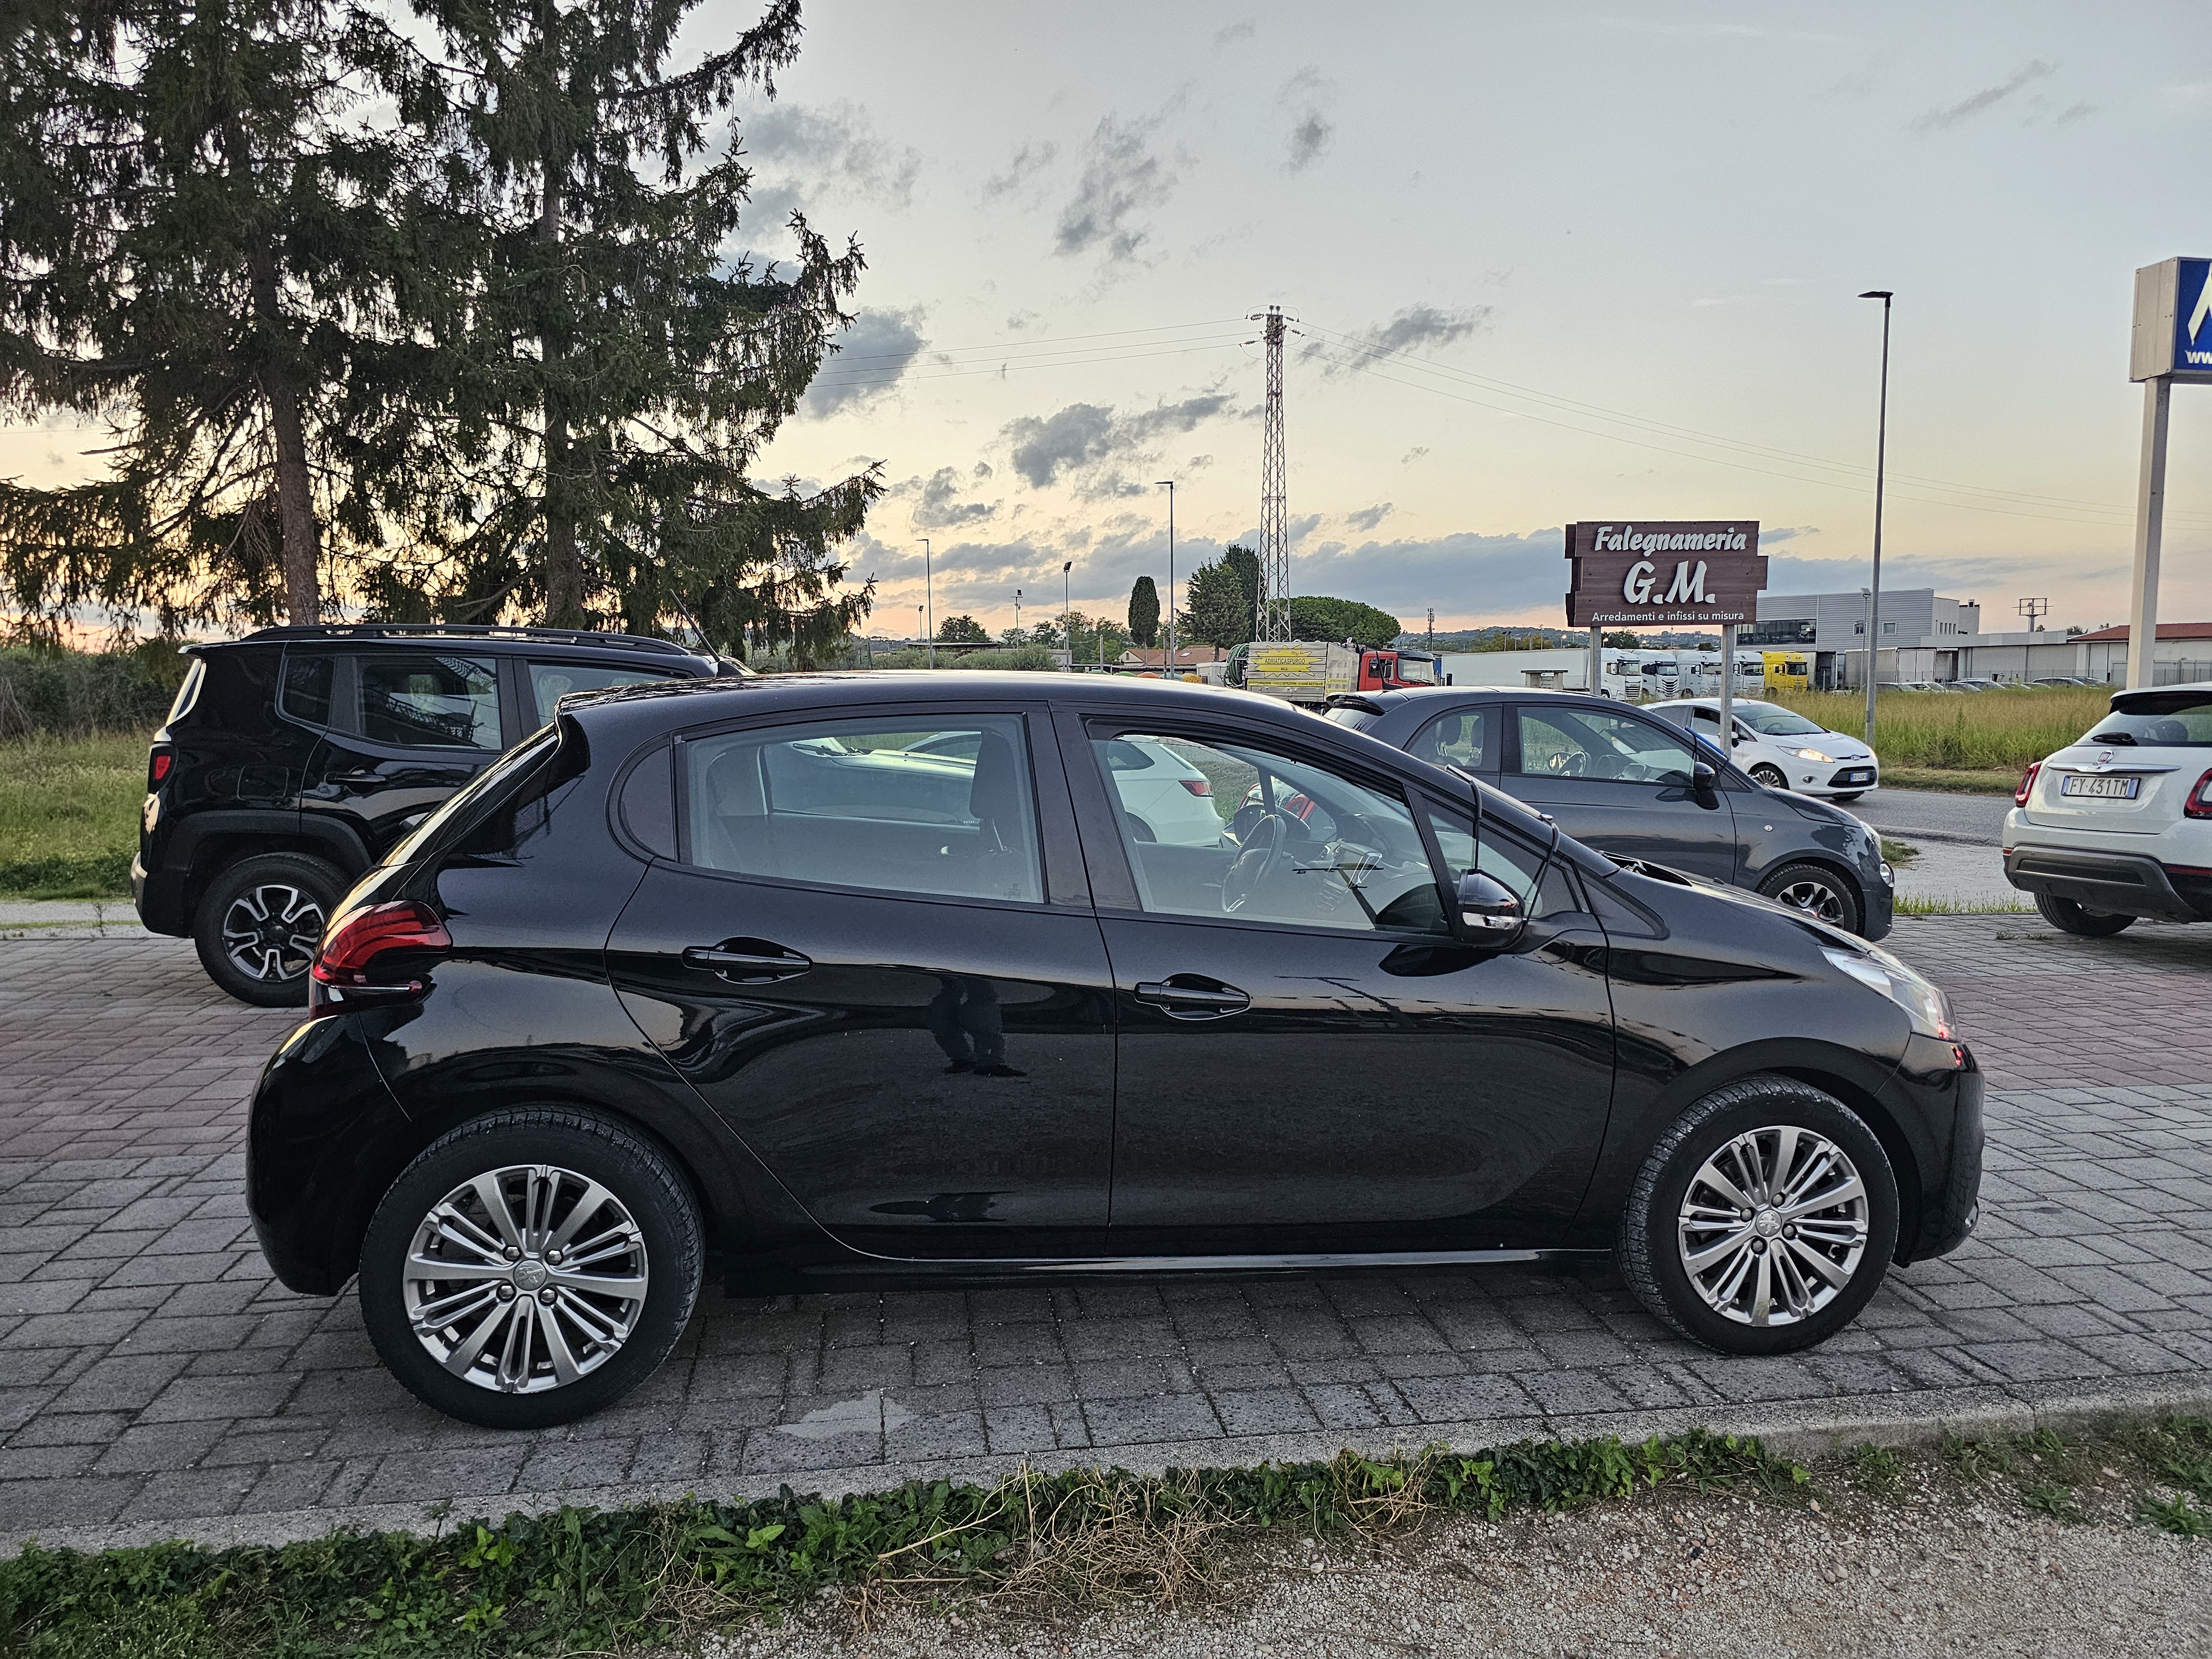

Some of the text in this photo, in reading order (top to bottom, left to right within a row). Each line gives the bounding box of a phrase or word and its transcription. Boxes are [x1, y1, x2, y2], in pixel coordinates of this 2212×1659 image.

[1594, 525, 1746, 557] Falegnameria
[1624, 560, 1715, 604] G.M.
[1592, 612, 1655, 621] Arredamenti
[1667, 611, 1695, 620] infissi
[1712, 611, 1744, 620] misura
